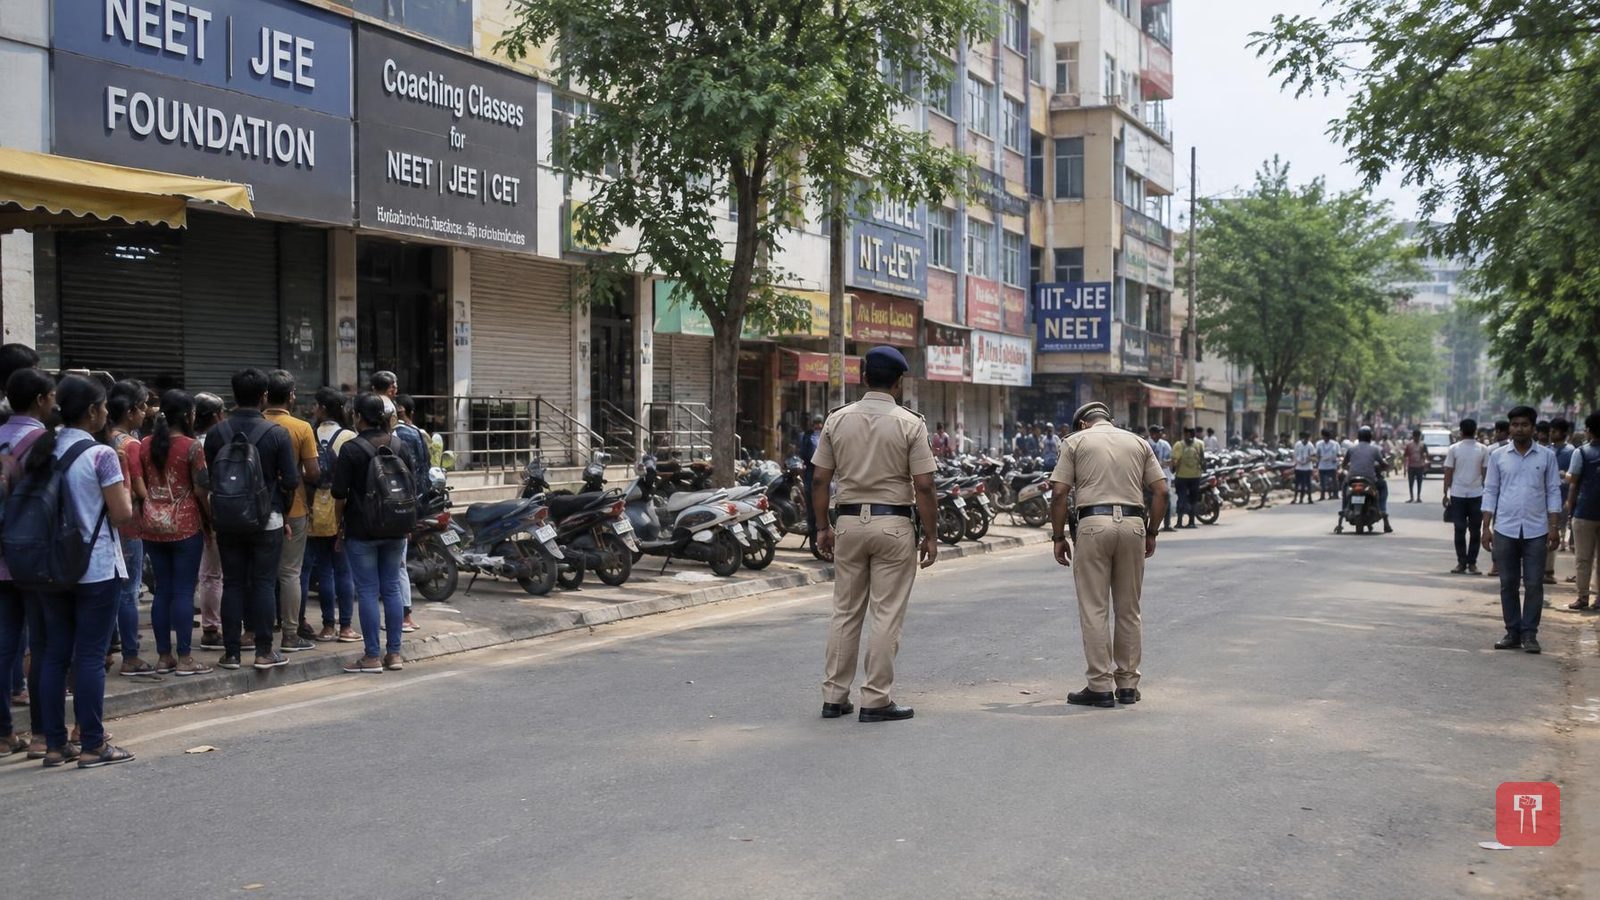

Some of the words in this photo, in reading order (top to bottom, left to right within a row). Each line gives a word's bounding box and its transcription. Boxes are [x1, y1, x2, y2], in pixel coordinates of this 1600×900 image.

[105, 0, 212, 60] NEET
[251, 27, 315, 88] JEE
[383, 58, 464, 118] Coaching
[468, 84, 524, 127] Classes
[107, 85, 315, 167] FOUNDATION
[450, 126, 466, 149] for
[387, 150, 433, 186] NEET
[449, 164, 478, 196] JEE
[492, 173, 520, 203] CET
[1040, 286, 1106, 310] IIT-JEE
[1045, 316, 1102, 340] NEET
